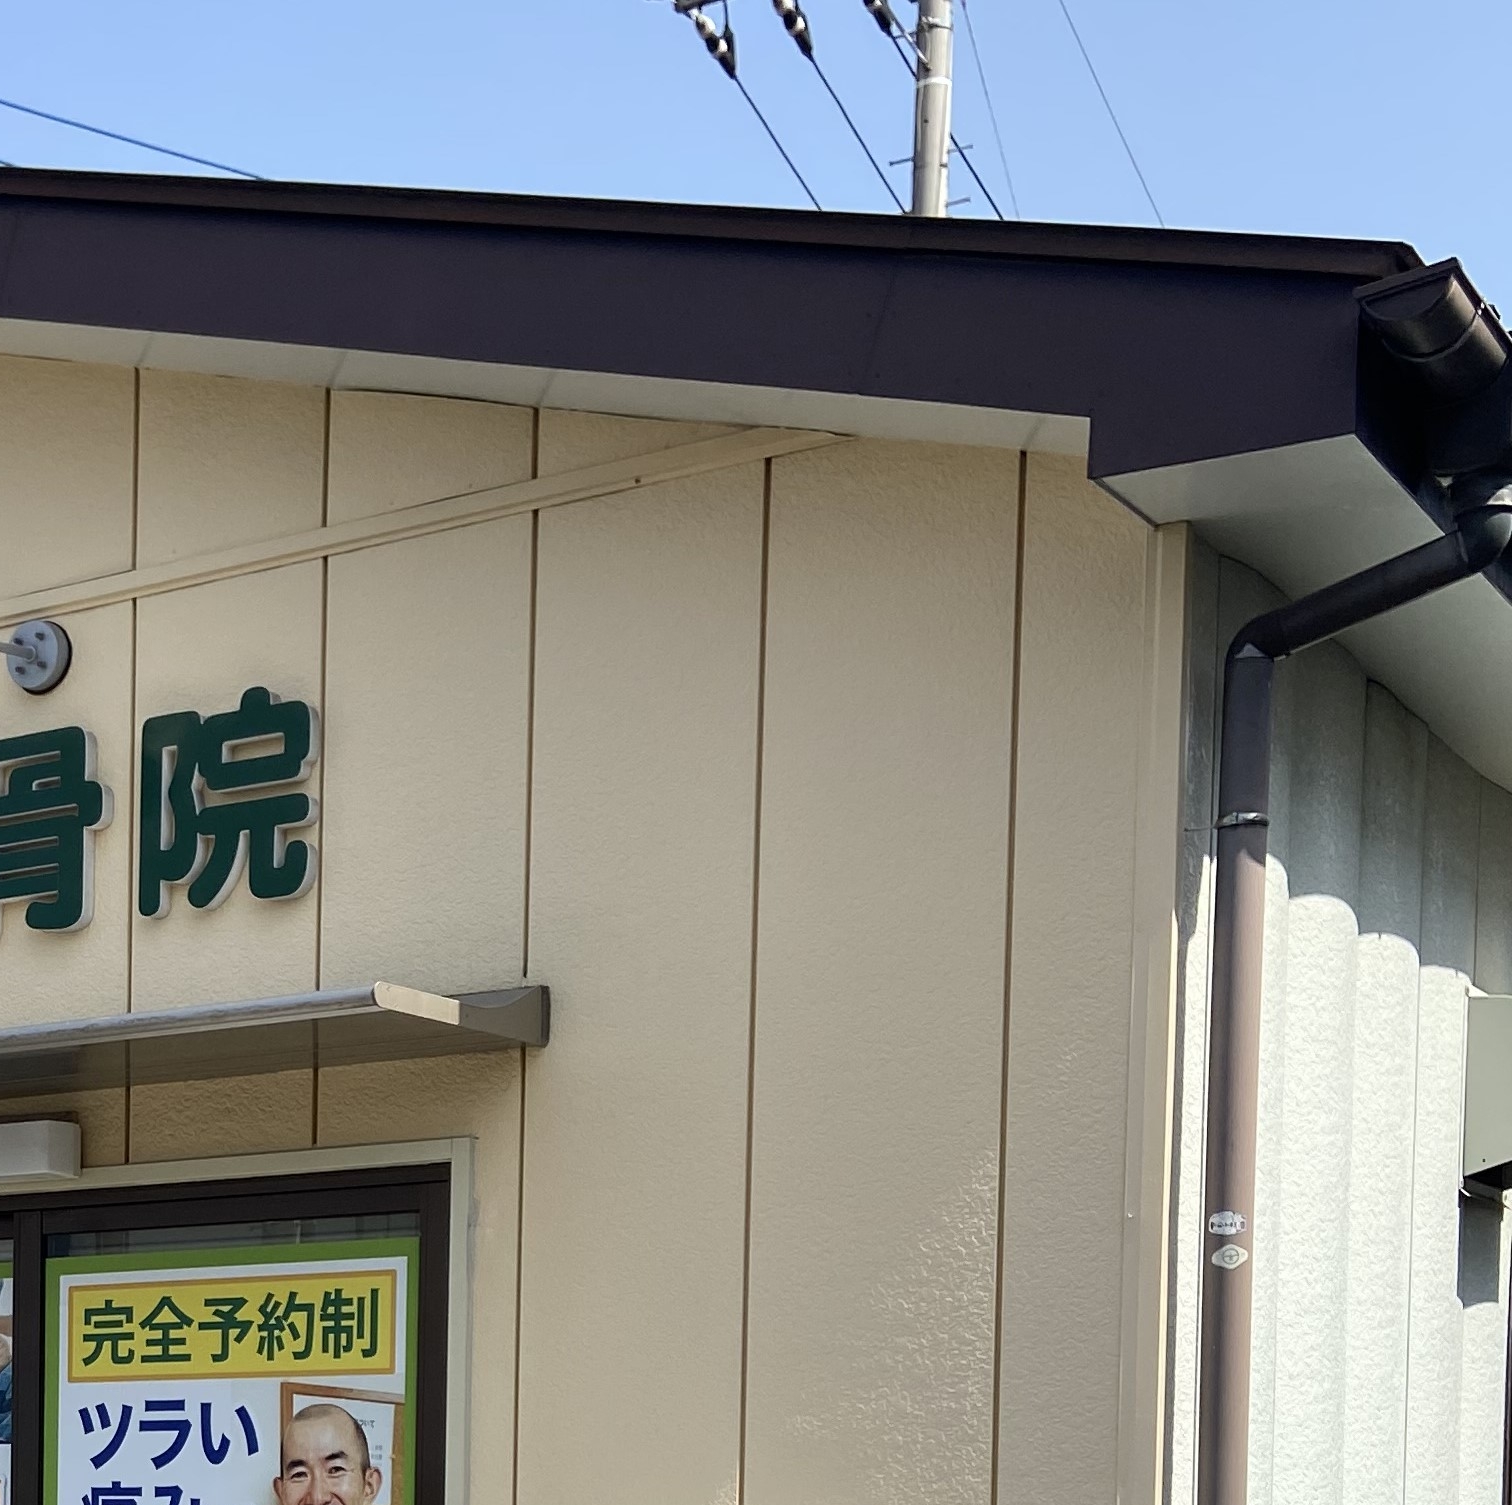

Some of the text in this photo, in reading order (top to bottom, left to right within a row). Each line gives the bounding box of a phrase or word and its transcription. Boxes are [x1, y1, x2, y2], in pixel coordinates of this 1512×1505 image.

[81, 1287, 381, 1367] 完全予約制
[77, 1398, 260, 1471] ツラい
